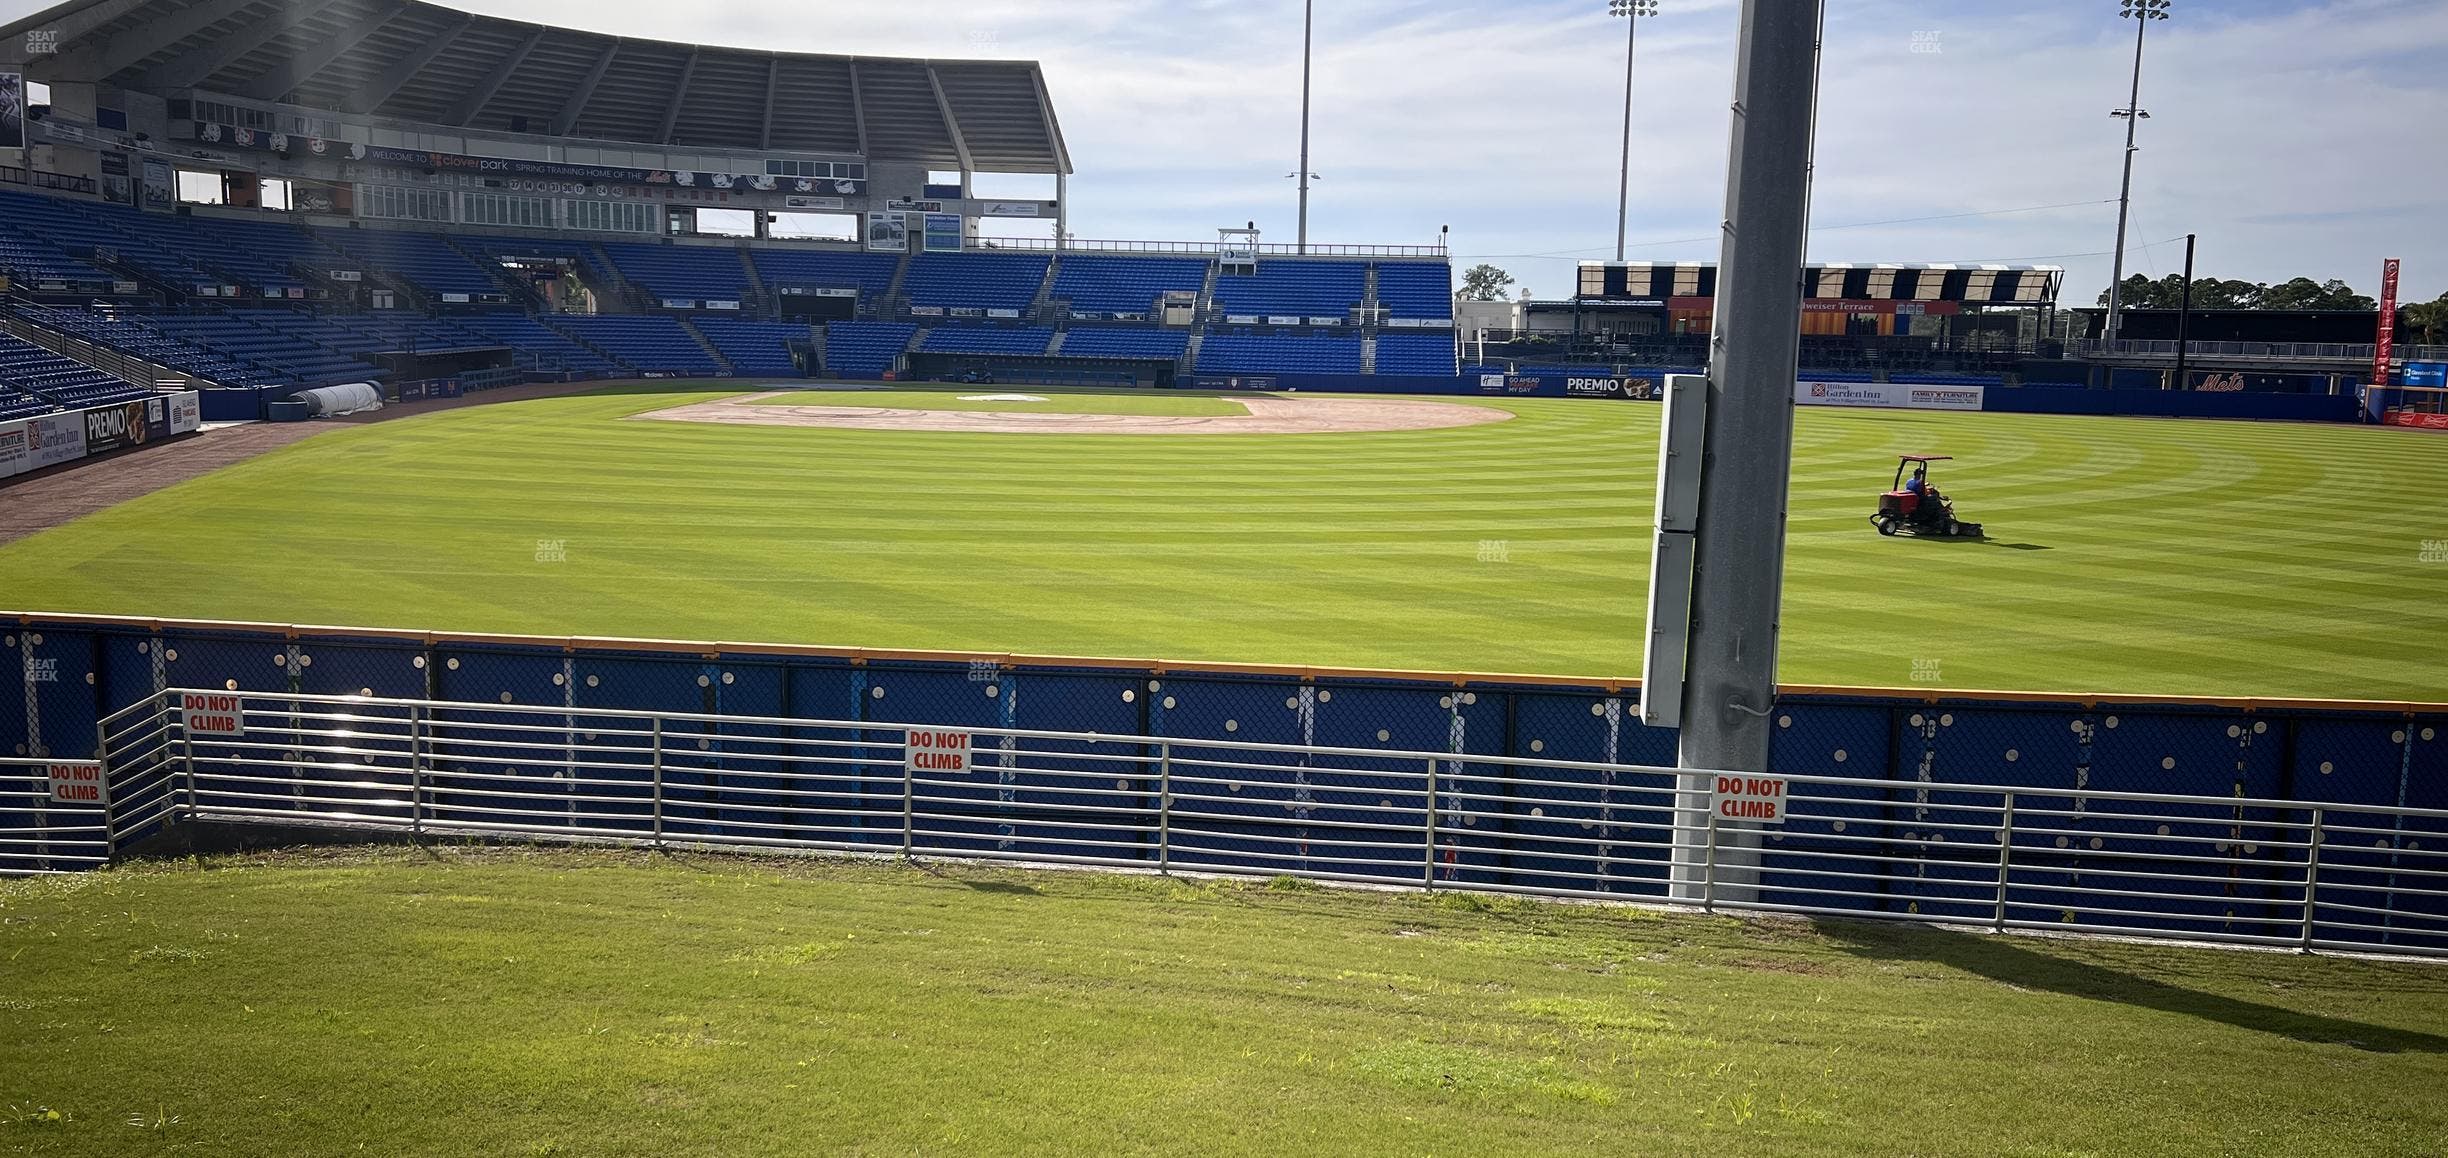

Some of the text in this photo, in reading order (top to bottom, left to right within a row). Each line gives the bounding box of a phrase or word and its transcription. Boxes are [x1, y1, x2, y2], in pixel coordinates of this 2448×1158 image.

[372, 150, 414, 162] WELCOME
[416, 154, 427, 164] TO
[515, 163, 546, 174] SPRING
[547, 165, 585, 177] TRAINING
[586, 168, 612, 178] HOME
[613, 170, 625, 179] OF
[627, 171, 643, 181] THE
[1839, 302, 1875, 312] Terrace
[1567, 378, 1619, 391] PREMIO
[1826, 383, 1849, 391] Hilton
[2195, 371, 2244, 392] Mets
[1826, 390, 1881, 399] Garden Inn
[88, 408, 125, 440] PREMIO
[40, 427, 79, 448] Garden Inn
[185, 694, 238, 712] DO NOT
[190, 714, 236, 732] CLIMB
[910, 731, 968, 750] DO NOT
[914, 752, 963, 769] CLIMB
[50, 765, 101, 781] DO NOT
[57, 784, 99, 800] CLIMB
[1718, 777, 1784, 797] DO NOT
[1721, 799, 1776, 819] CLIMB
